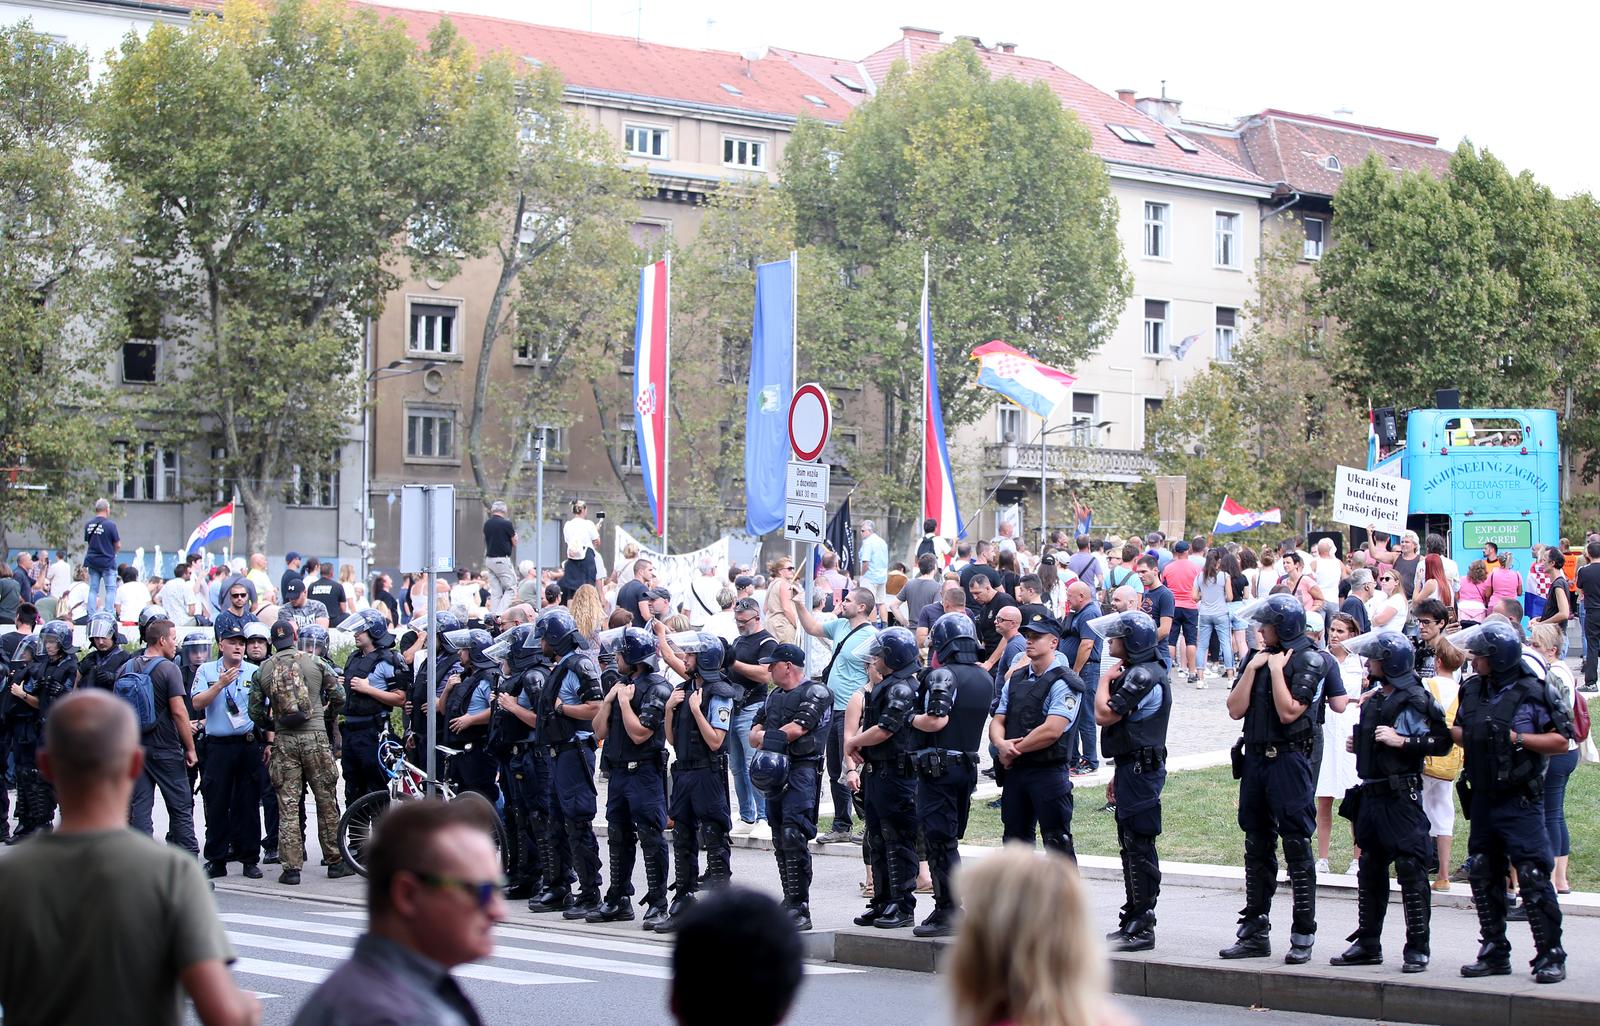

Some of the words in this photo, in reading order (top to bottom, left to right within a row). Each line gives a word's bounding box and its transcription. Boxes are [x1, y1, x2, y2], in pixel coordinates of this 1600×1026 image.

[1347, 473, 1379, 488] Ukrali
[1380, 481, 1396, 491] ste
[1423, 461, 1503, 494] SIGHTSEEING
[1504, 463, 1549, 493] ZAGREB
[1451, 480, 1521, 490] ROUTEMASTER
[1346, 487, 1398, 506] budućnost
[1469, 490, 1502, 499] TOUR
[1342, 502, 1369, 517] našoj
[1371, 507, 1399, 521] djeci!
[1475, 525, 1520, 534] EXPLORE
[1478, 535, 1517, 544] ZAGREB
